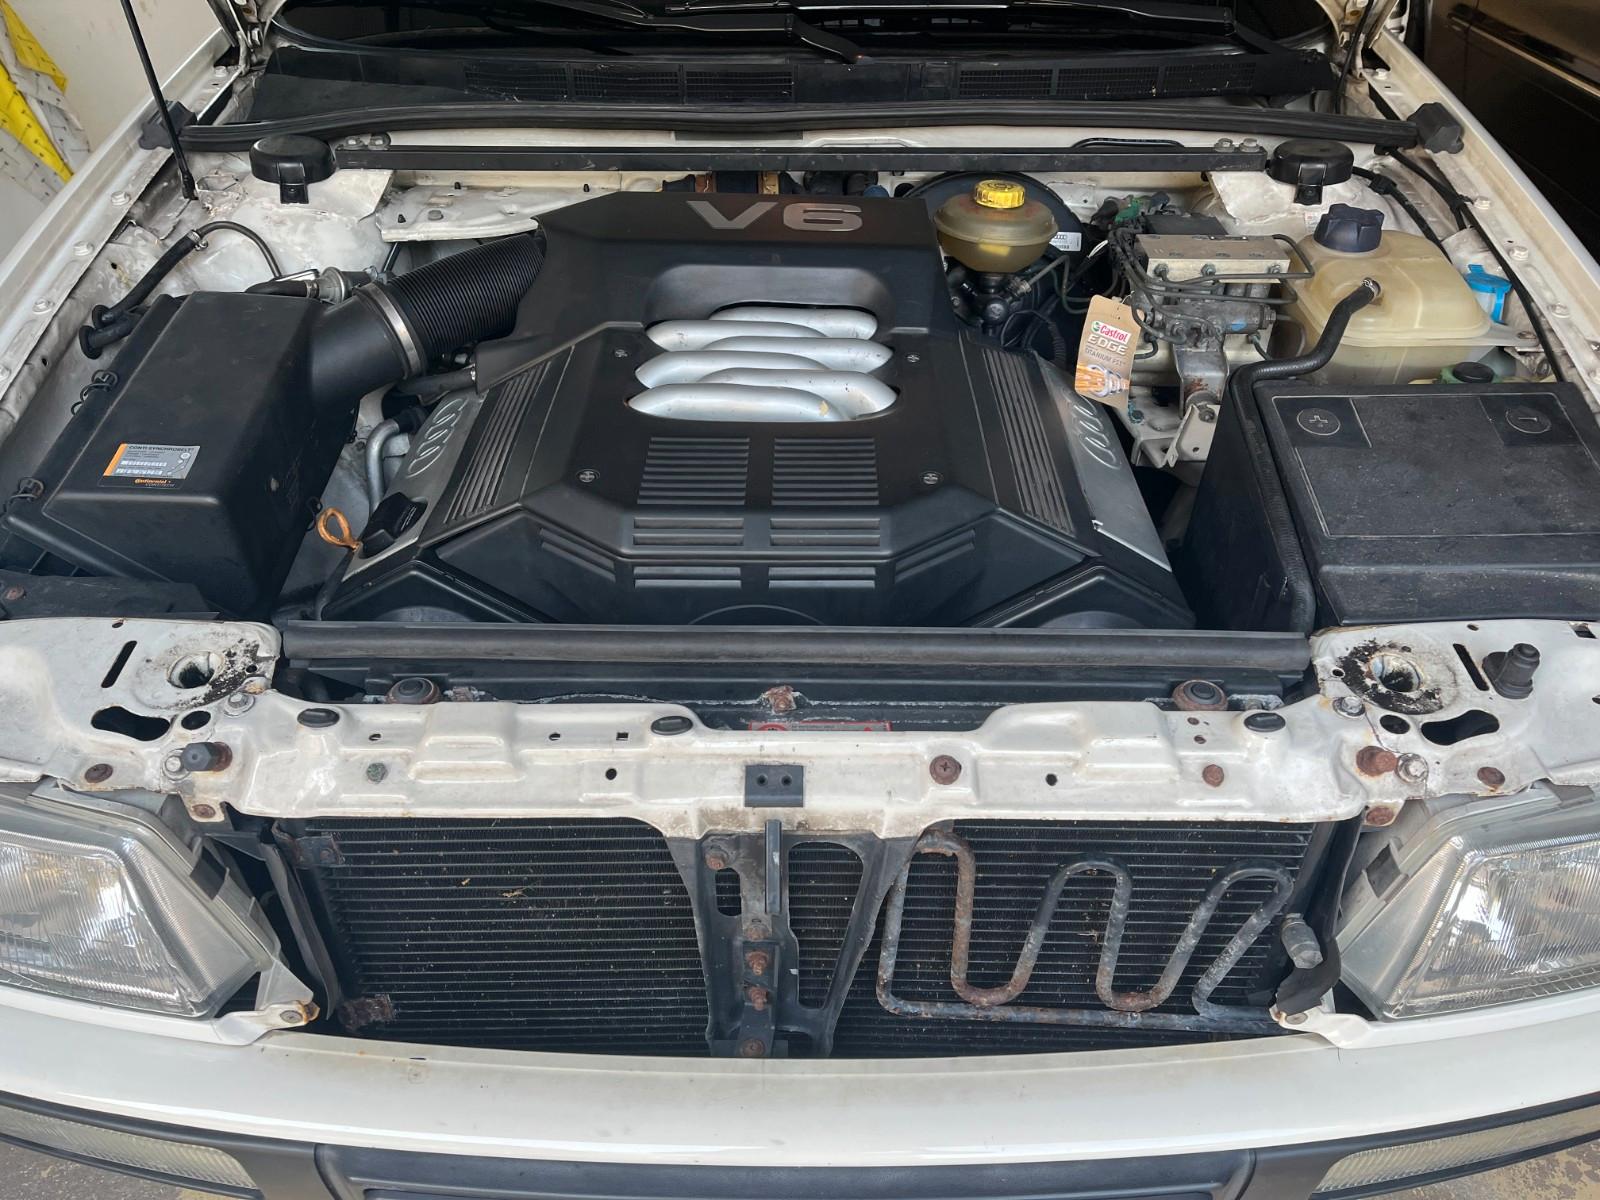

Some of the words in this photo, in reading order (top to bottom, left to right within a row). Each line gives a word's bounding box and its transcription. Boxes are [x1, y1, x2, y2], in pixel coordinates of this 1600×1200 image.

[686, 200, 863, 232] V6
[1100, 325, 1128, 342] Castrol
[1088, 334, 1129, 355] EDGE
